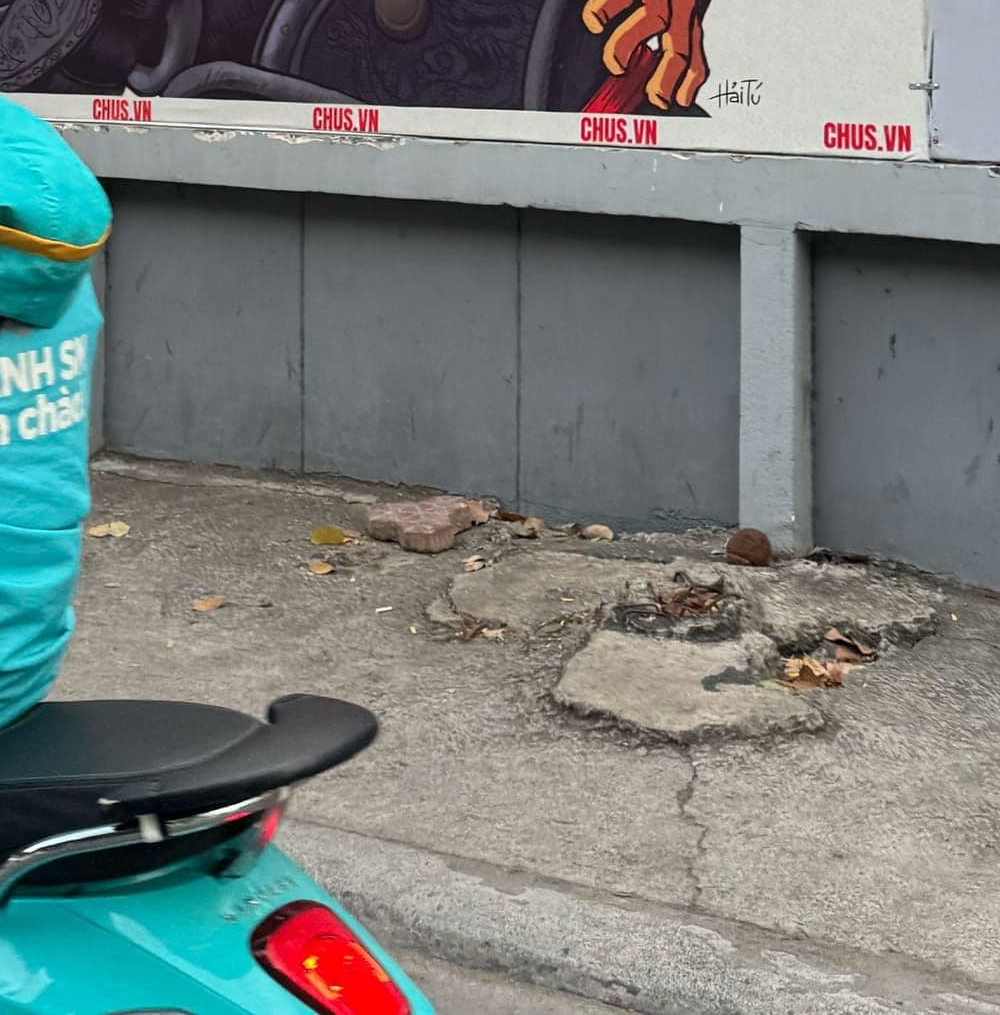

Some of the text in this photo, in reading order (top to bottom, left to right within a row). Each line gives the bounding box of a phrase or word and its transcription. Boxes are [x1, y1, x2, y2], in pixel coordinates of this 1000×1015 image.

[92, 98, 152, 122] CHUS.VN
[312, 106, 379, 132] CHUS.VN
[580, 117, 657, 145] CHUS.VN
[823, 122, 912, 152] CHUS.VN
